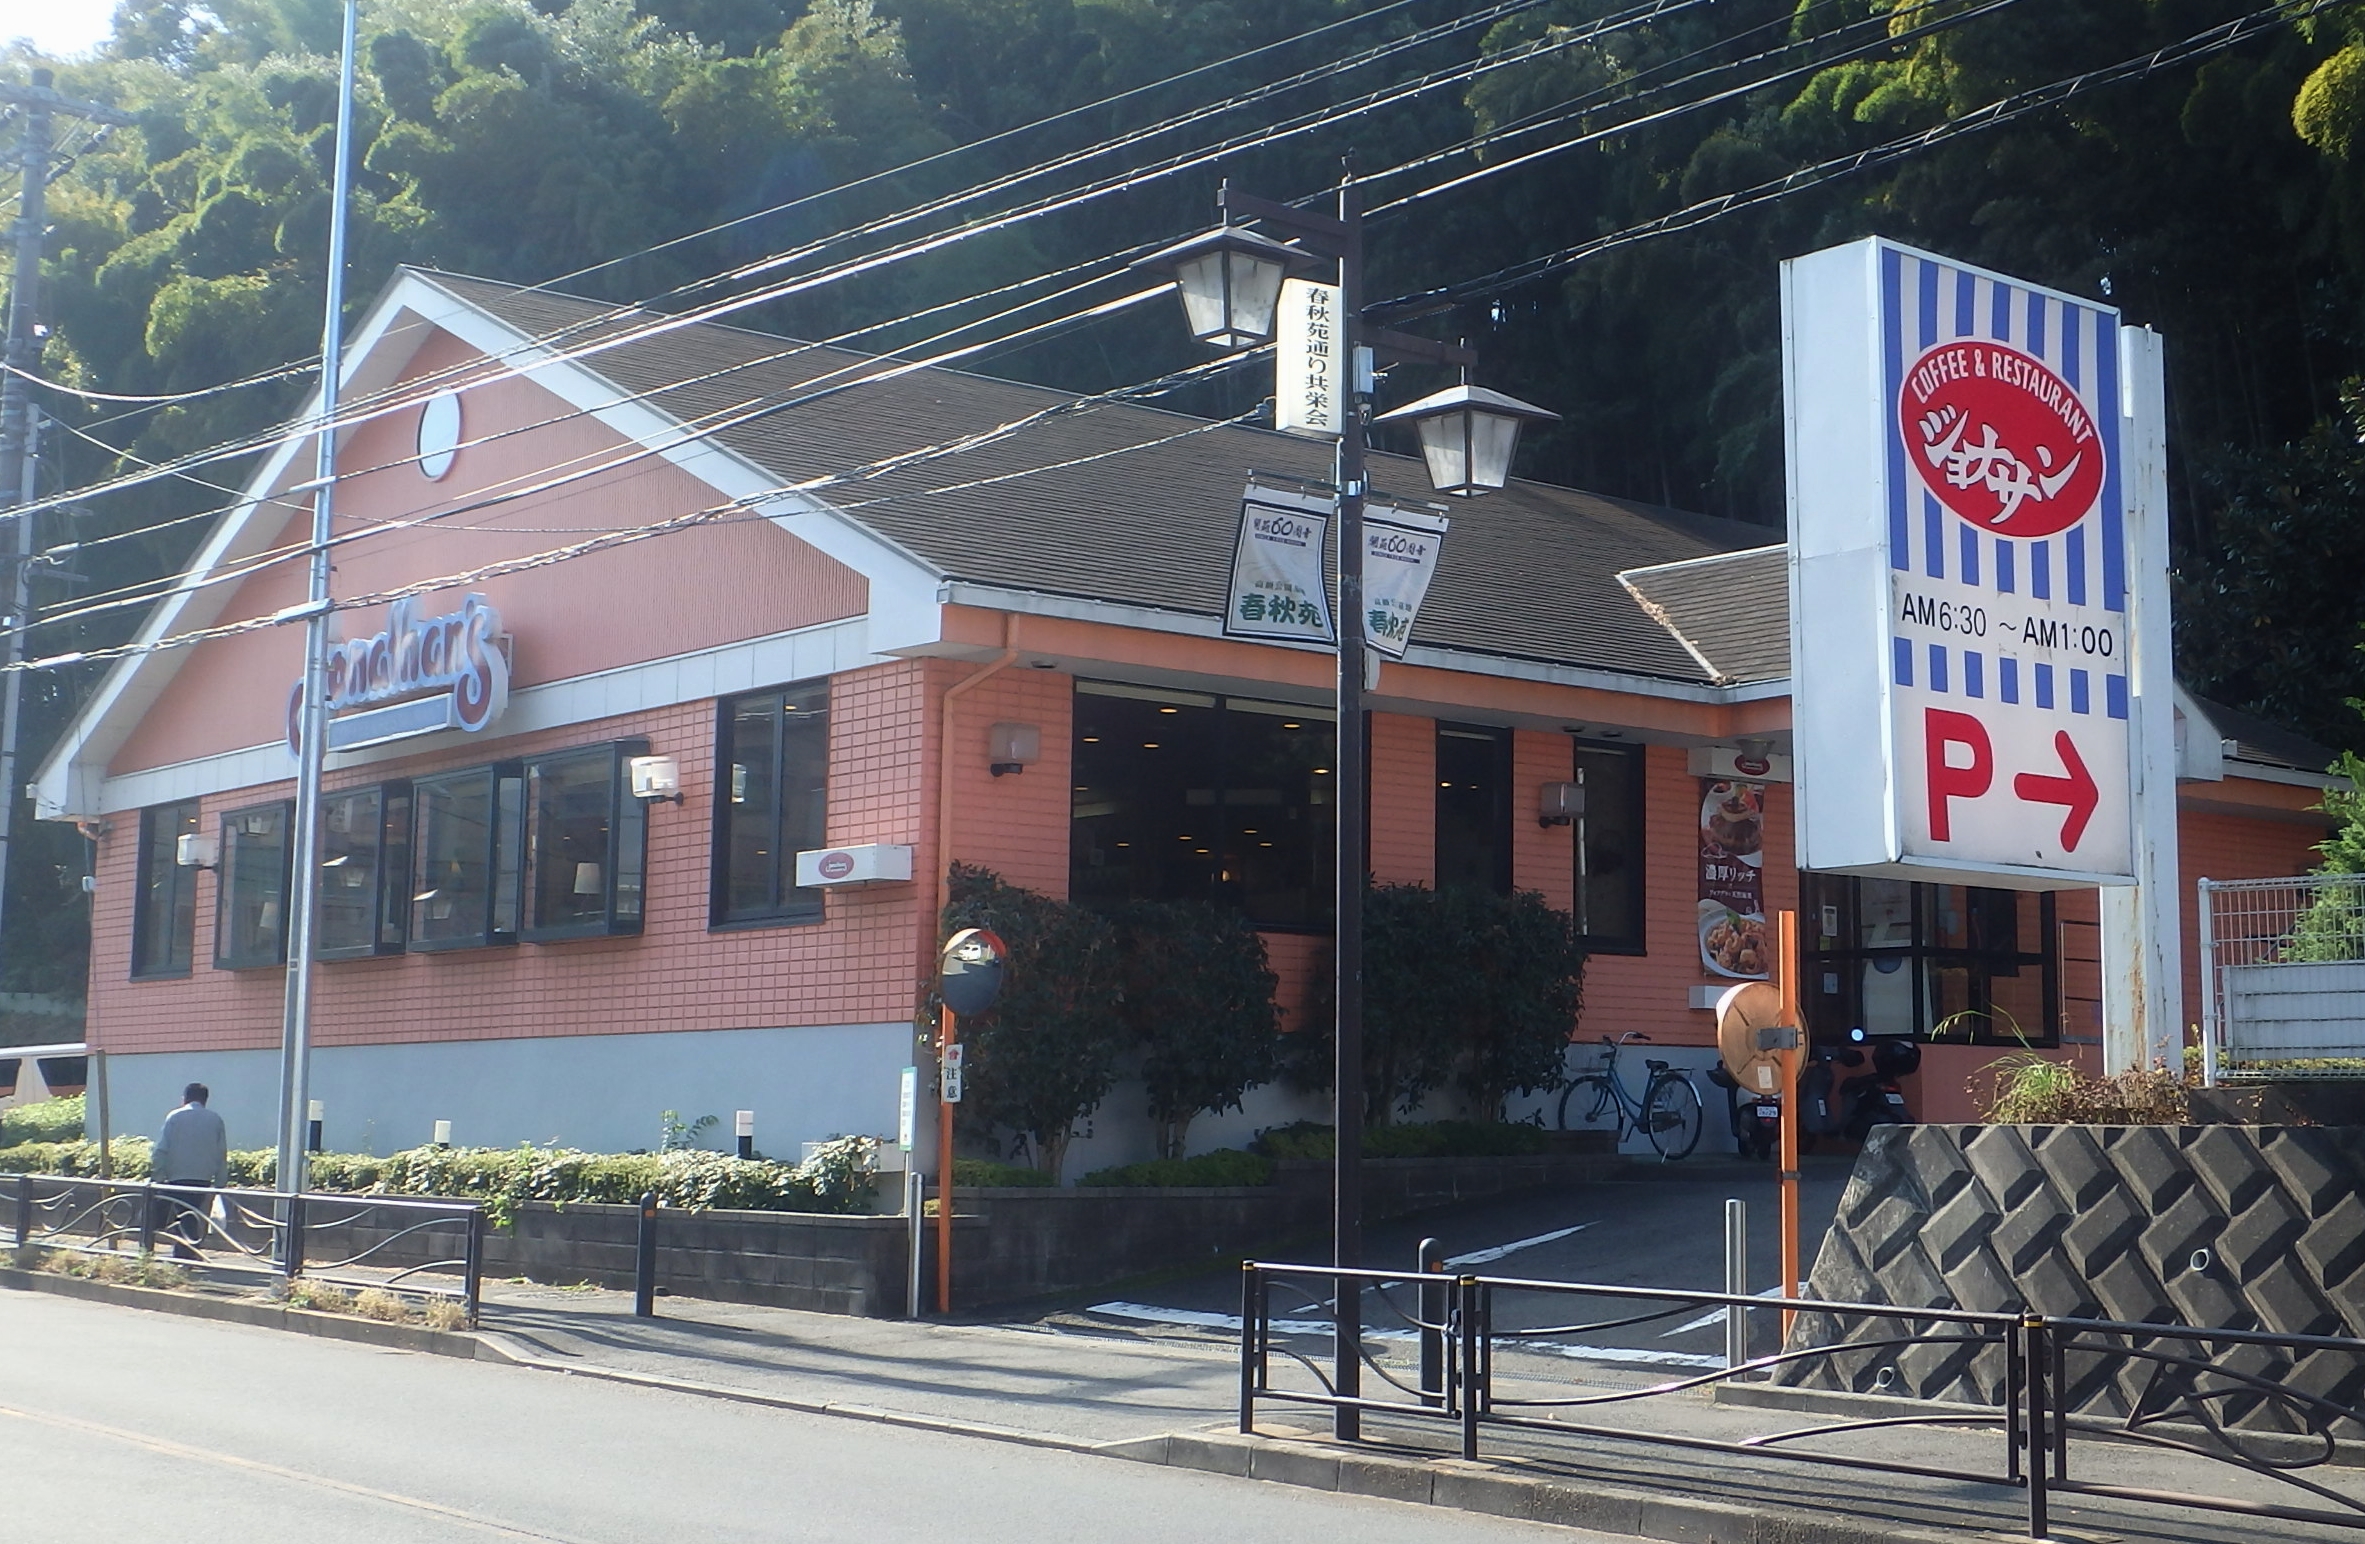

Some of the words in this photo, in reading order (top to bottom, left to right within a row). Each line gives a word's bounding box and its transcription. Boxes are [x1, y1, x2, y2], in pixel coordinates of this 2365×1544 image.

[1306, 287, 1330, 427] 春秋苑通り共栄会
[1911, 348, 1969, 404] COFFEE
[1974, 348, 1986, 377] &
[1992, 351, 2094, 444] RESTAURANT
[1918, 404, 2083, 524] ジョナサン
[1240, 593, 1324, 628] 春秋苑
[1901, 593, 1987, 638] AM6:30
[2023, 616, 2114, 657] AM1:00
[1924, 707, 1994, 842] P
[1705, 864, 1757, 883] 濃厚リッチ
[946, 1067, 958, 1099] 注意
